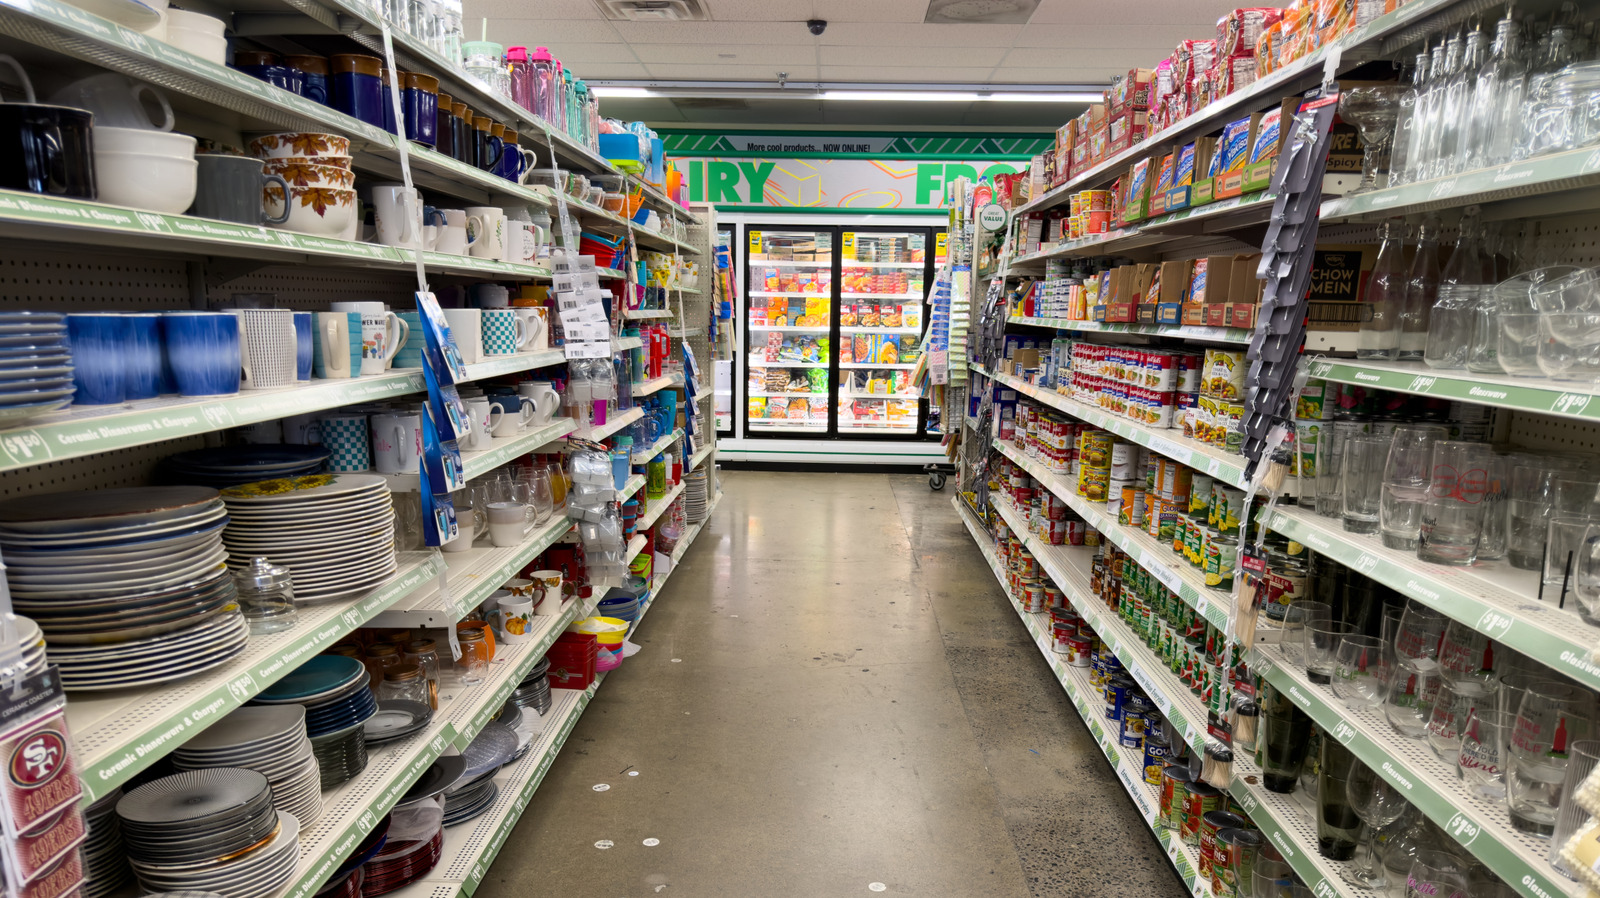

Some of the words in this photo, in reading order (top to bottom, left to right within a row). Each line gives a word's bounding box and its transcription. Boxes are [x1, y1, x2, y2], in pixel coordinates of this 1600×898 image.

[748, 143, 766, 151] More
[768, 143, 782, 151] cool
[823, 144, 840, 152] NOW
[842, 144, 870, 152] ONLINE!
[1328, 158, 1355, 167] Spicy
[689, 161, 776, 203] IRY
[1310, 281, 1352, 294] MEIN
[1311, 269, 1354, 280] CHOW
[1354, 372, 1380, 382] Glassware
[1469, 386, 1507, 399] Glassware
[58, 428, 99, 444] Ceramic
[99, 422, 151, 438] Dinnerware
[162, 414, 198, 428] Chargers
[1407, 580, 1440, 601] Glassware
[259, 660, 284, 678] Ceramic
[283, 640, 315, 663] Dinnerware
[318, 624, 340, 641] Chargers
[1560, 650, 1600, 678] Glasswa
[1134, 668, 1146, 684] Extreme
[1144, 680, 1153, 693] Value
[1151, 690, 1165, 707] Everyday
[1290, 686, 1312, 707] Glassware
[2, 700, 30, 718] CERAMIC
[28, 688, 54, 704] COASTER
[98, 753, 137, 780] Ceramic
[135, 724, 184, 757] Dinnerware
[184, 716, 193, 727] &
[192, 697, 224, 722] Chargers
[1382, 762, 1413, 790] Glassware
[1460, 754, 1501, 774] Wine
[376, 793, 394, 811] Ceramic
[391, 772, 414, 794] Dinnerware
[414, 752, 432, 770] Chargers
[1120, 769, 1132, 786] Extreme
[1130, 784, 1138, 796] Value
[1136, 792, 1150, 816] Everyday
[24, 774, 74, 821] 49ERS
[30, 816, 76, 869] 49ERS
[1274, 831, 1294, 857] Glassware
[302, 860, 332, 894] Dinnerware
[335, 834, 356, 856] Chargers
